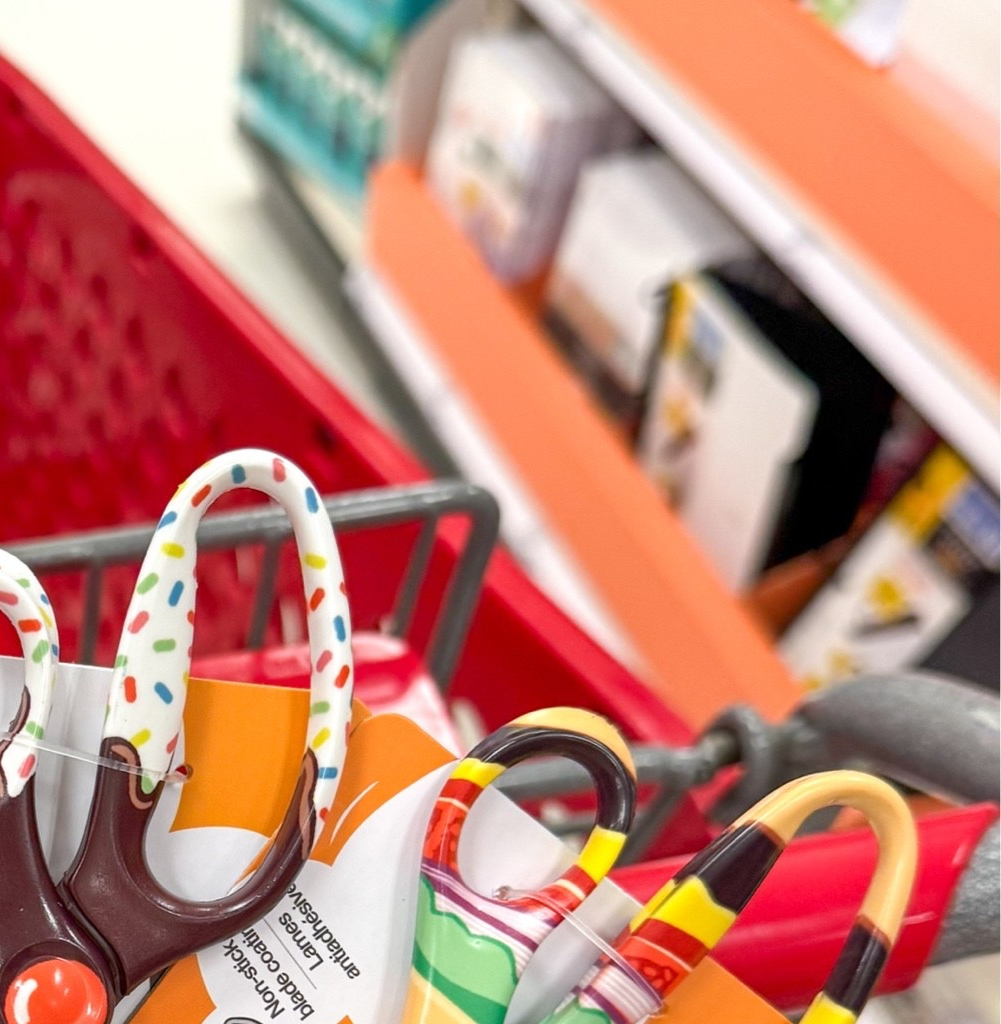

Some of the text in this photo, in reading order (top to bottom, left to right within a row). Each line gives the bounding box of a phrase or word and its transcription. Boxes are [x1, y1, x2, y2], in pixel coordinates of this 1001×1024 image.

[241, 928, 315, 1021] blade coatin
[279, 912, 324, 971] Lames
[287, 883, 360, 979] antiadhésive
[223, 938, 285, 1019] Non-stick
